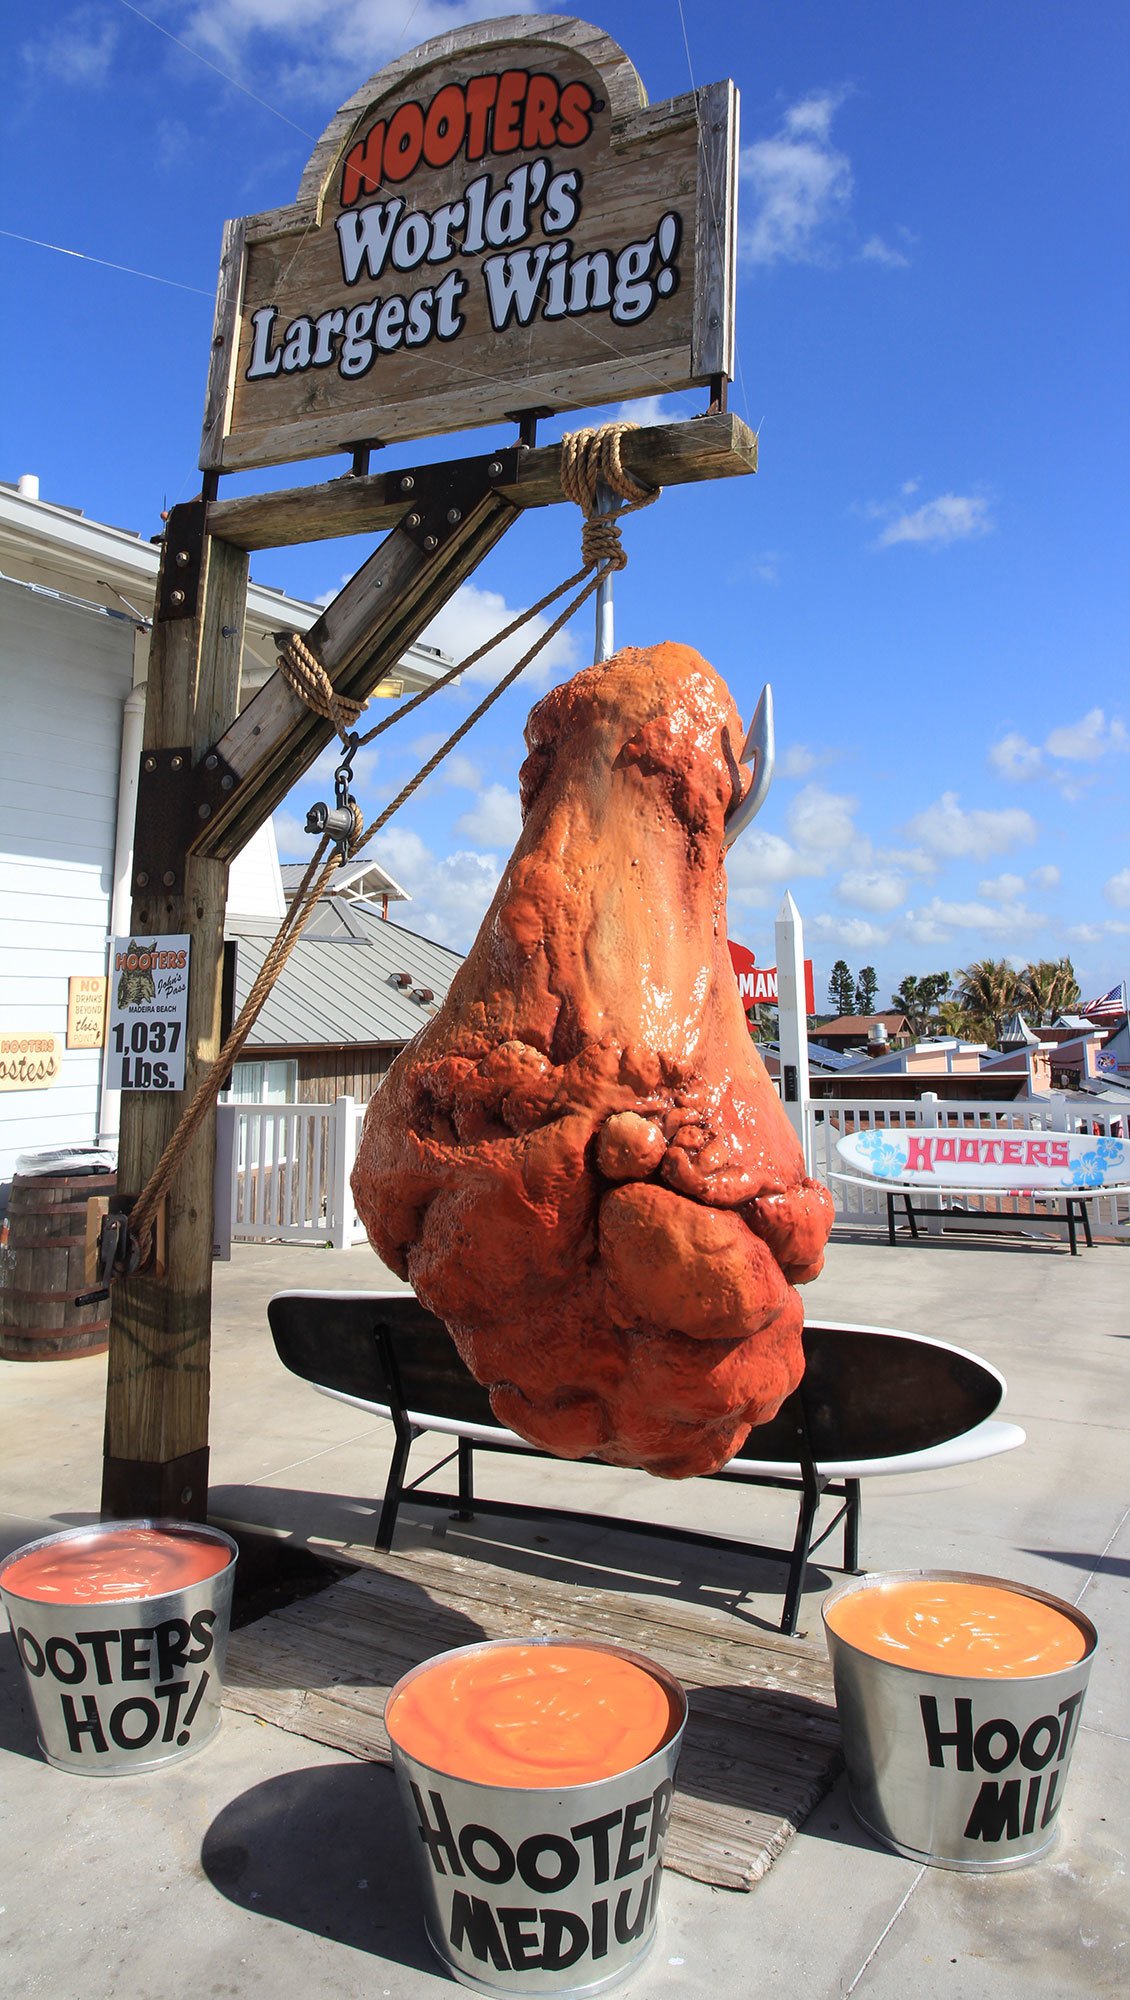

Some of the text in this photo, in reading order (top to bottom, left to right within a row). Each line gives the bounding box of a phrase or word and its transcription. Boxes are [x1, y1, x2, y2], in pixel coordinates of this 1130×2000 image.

[341, 69, 593, 205] HOOTERS
[336, 158, 582, 286] World's
[245, 211, 682, 380] Largest Wing!
[115, 950, 187, 971] HOOTERS
[80, 980, 100, 992] NO
[158, 973, 181, 995] John's
[165, 984, 186, 998] Pass
[734, 973, 779, 998] MAN
[75, 994, 103, 1004] DRINKS
[75, 1005, 102, 1014] BEYOND
[156, 1005, 177, 1013] BEACH
[75, 1016, 99, 1032] this
[0, 1039, 54, 1053] HOOTERS
[112, 1022, 182, 1056] 1,037
[121, 1057, 175, 1088] Lbs.
[904, 1136, 1071, 1173] HOOTERS
[17, 1609, 217, 1685] OOTERS
[60, 1670, 210, 1753] HOT!
[920, 1685, 1088, 1774] HOOT
